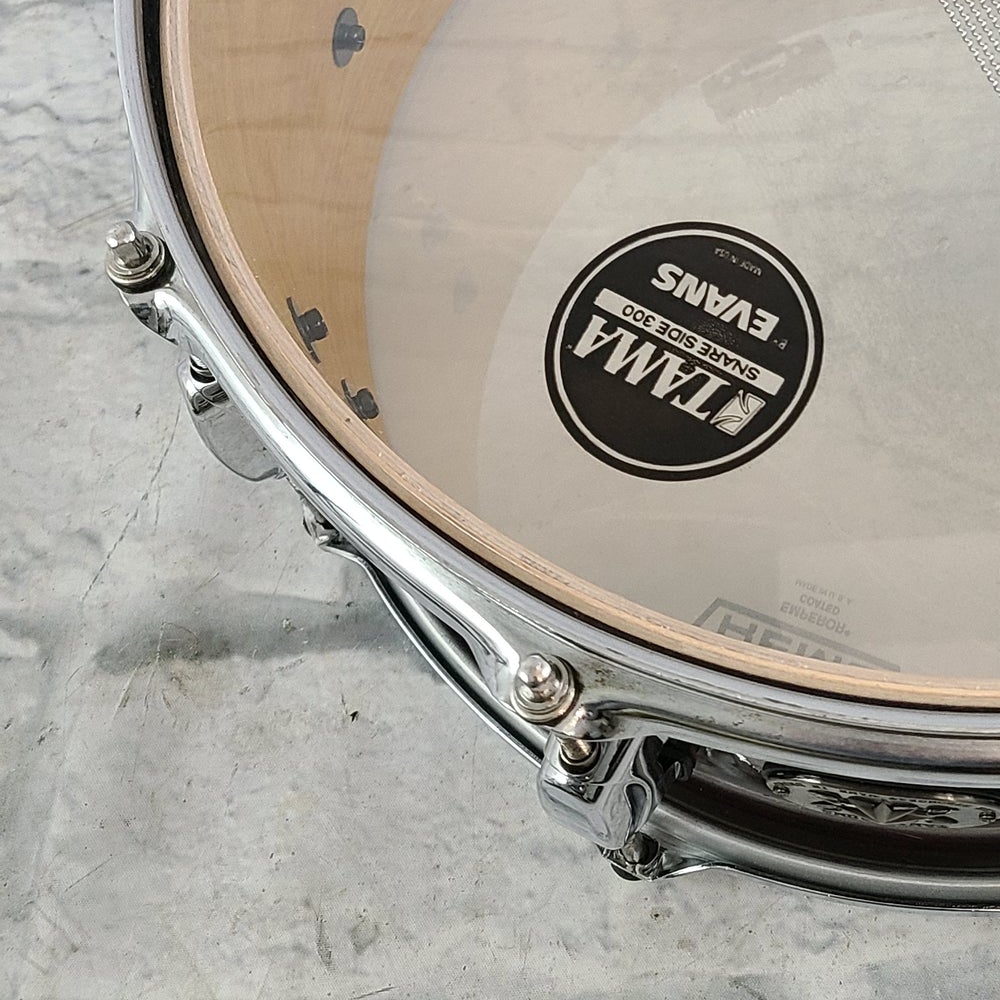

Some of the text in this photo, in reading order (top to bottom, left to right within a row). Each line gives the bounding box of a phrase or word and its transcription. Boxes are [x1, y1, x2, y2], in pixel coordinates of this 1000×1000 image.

[650, 262, 780, 342] EVANS
[573, 314, 732, 421] TAMA
[622, 304, 761, 381] SNARE SIDE 300
